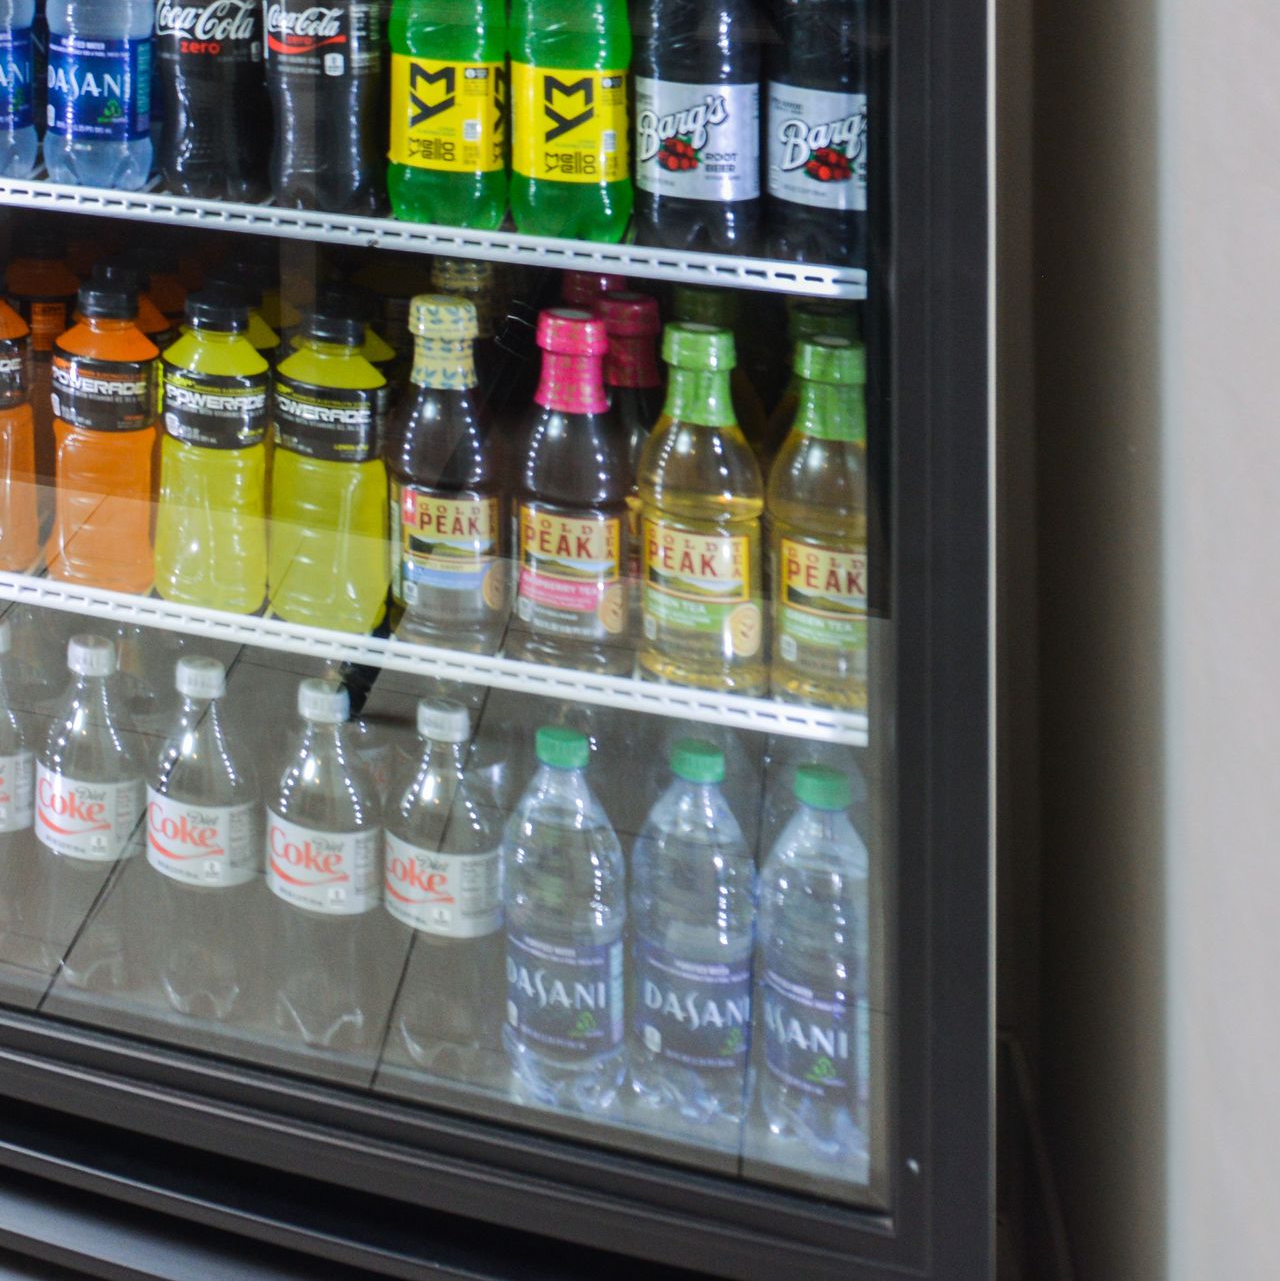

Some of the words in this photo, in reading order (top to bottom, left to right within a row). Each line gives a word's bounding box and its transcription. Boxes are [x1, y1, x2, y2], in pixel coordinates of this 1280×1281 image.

[268, 4, 344, 36] Coca-Cola
[180, 40, 221, 54] zero
[639, 95, 729, 161] Barq's
[704, 152, 738, 163] ROOT
[704, 163, 737, 173] BEER
[165, 384, 265, 411] POWERADE
[420, 502, 481, 516] GOLD
[420, 512, 480, 536] PEAK
[525, 525, 592, 558] PEAK
[649, 540, 719, 577] PEAK
[787, 557, 865, 595] PEAK
[38, 777, 106, 822] Coke
[148, 801, 219, 848] Coke
[269, 824, 345, 874] Coke
[506, 955, 607, 1010] DASANI
